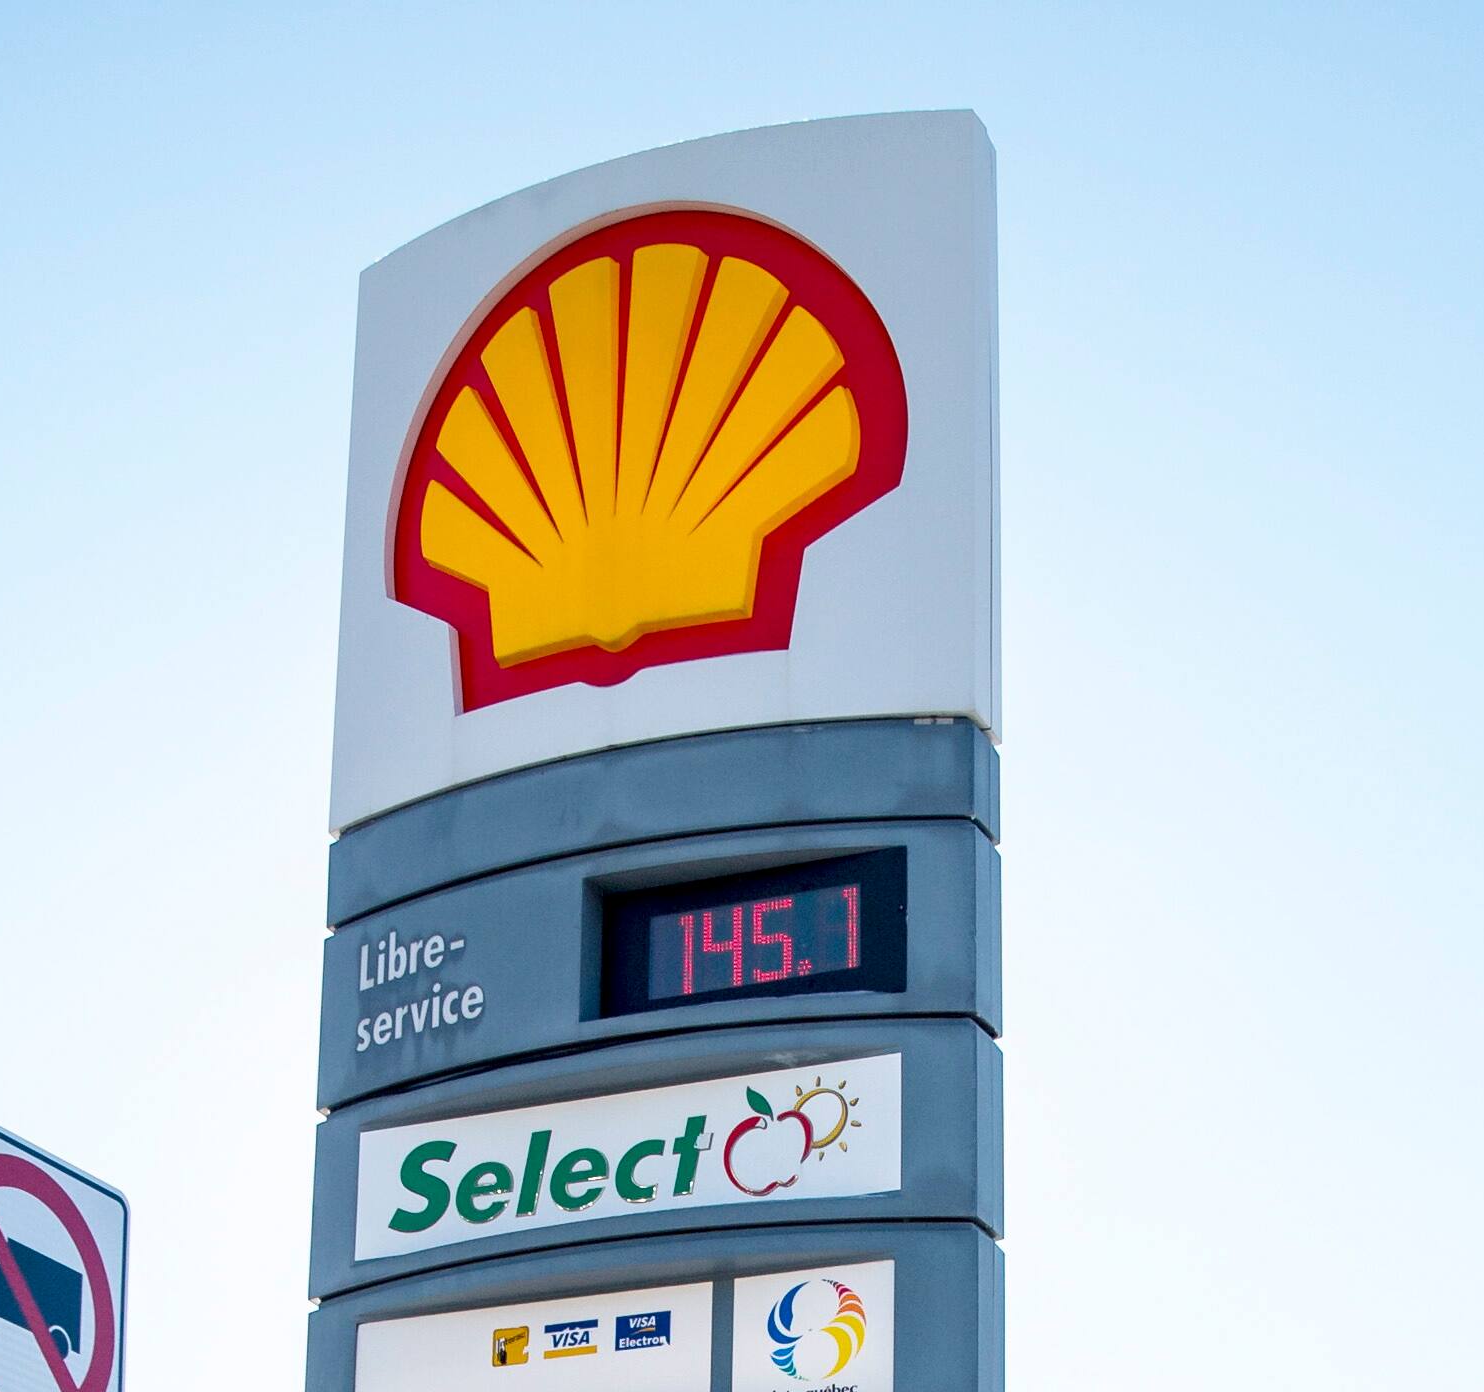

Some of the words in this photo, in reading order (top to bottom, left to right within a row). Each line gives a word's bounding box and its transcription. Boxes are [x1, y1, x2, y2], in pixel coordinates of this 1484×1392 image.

[359, 929, 466, 993] Libre-
[679, 886, 859, 995] 145.1
[355, 982, 485, 1052] service
[388, 1115, 709, 1233] Select
[551, 1330, 591, 1348] VISA
[618, 1334, 666, 1349] Electron
[629, 1315, 656, 1329] VISA
